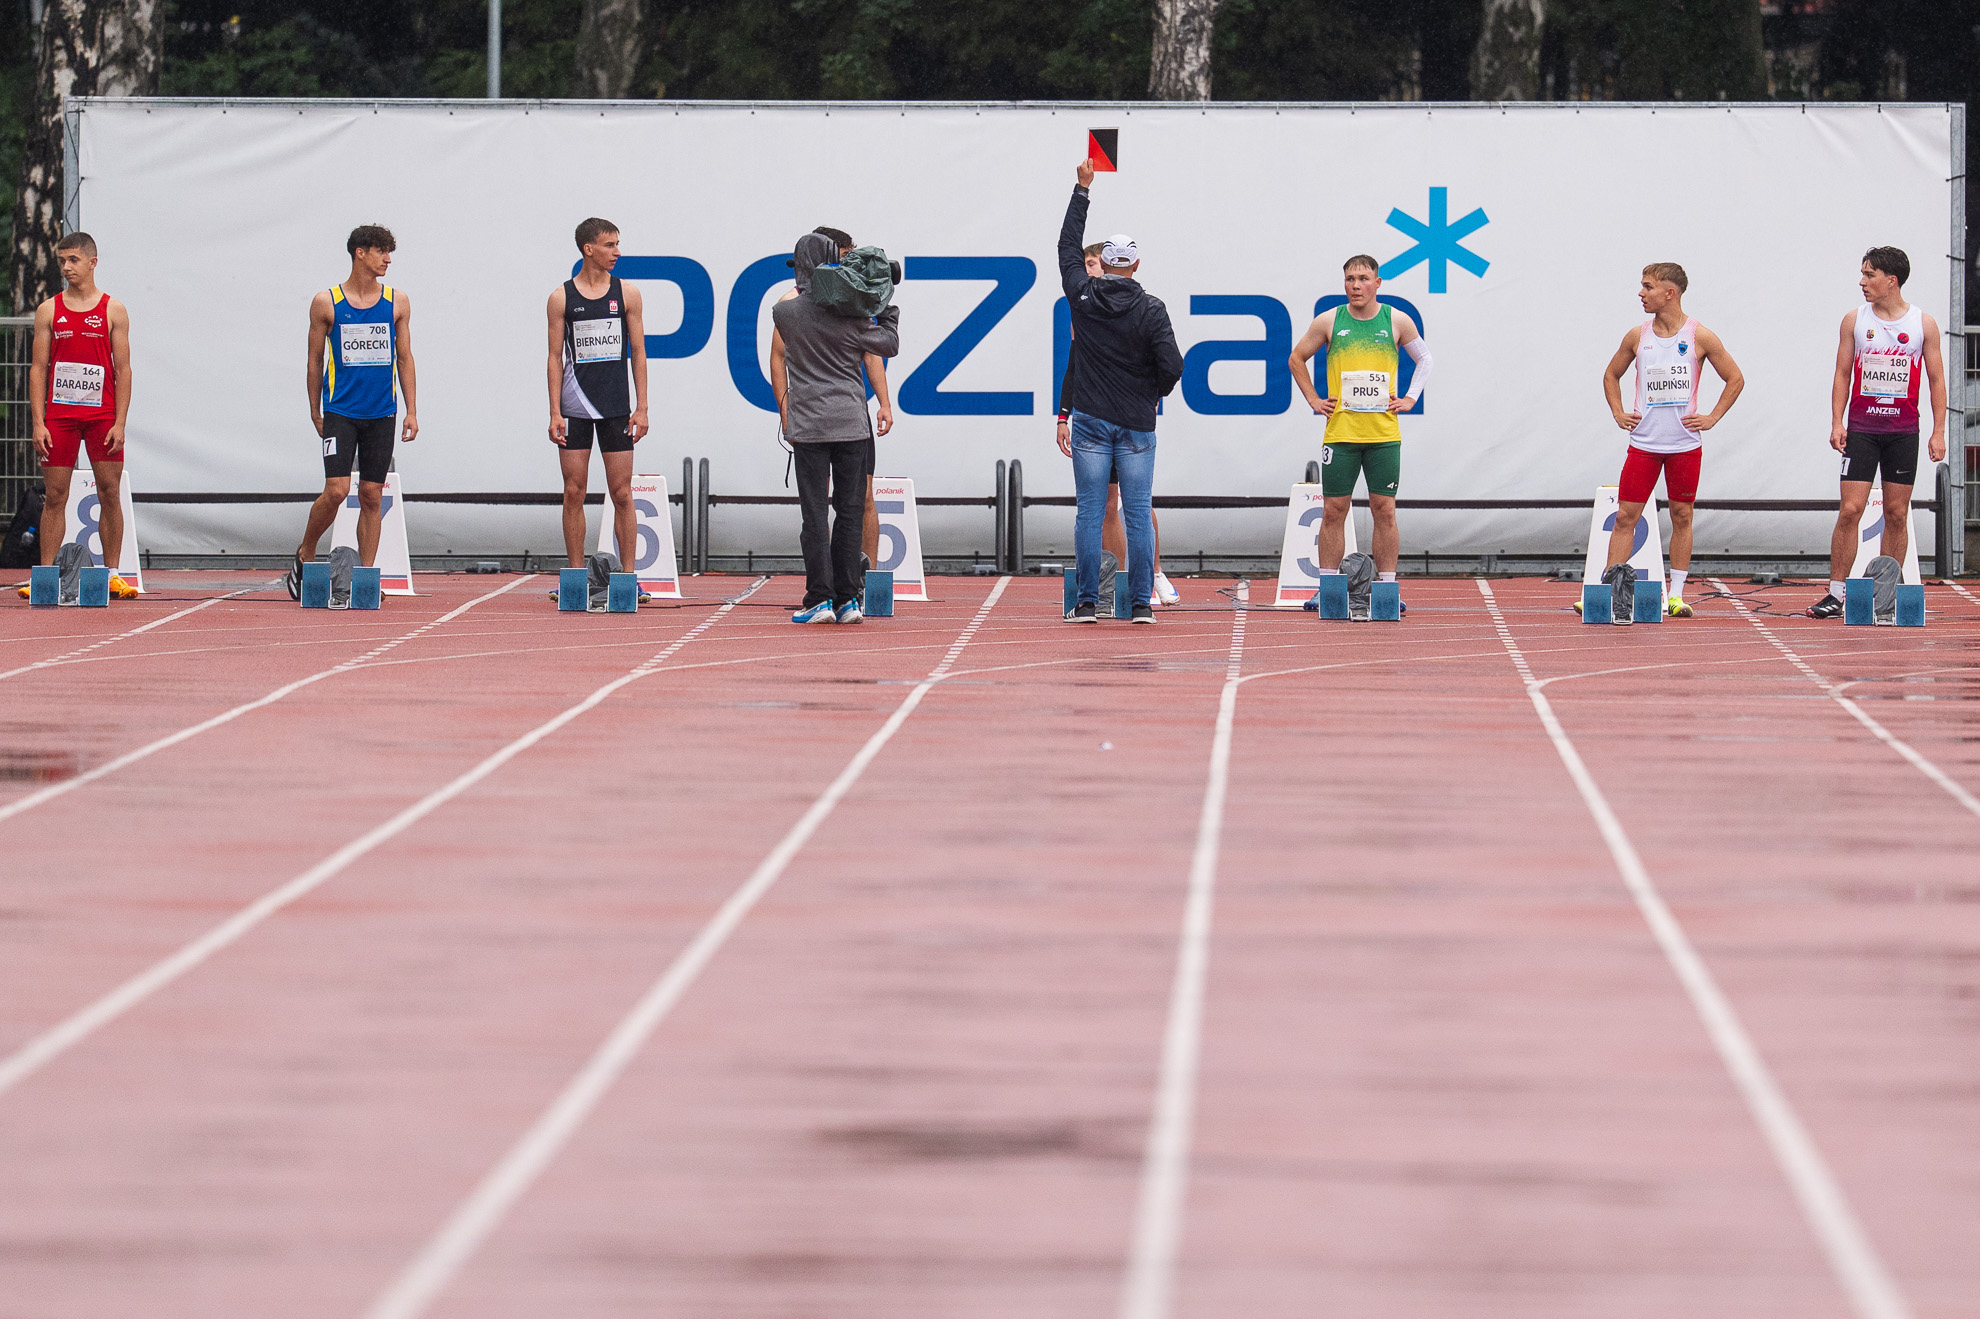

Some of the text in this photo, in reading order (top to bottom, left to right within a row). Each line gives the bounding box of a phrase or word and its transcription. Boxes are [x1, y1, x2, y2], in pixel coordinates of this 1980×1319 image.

[369, 326, 386, 335] 708
[606, 321, 612, 329] 7
[343, 338, 389, 350] GÓRECKI
[576, 335, 620, 347] BIERNACKI
[1890, 358, 1907, 367] 180
[82, 367, 100, 376] 164
[1670, 366, 1687, 374] 531
[1863, 370, 1908, 382] MARIASZ
[1369, 374, 1386, 382] 551
[56, 379, 101, 391] BARABAS
[1647, 378, 1690, 391] KULPIŃSKI
[1353, 387, 1379, 396] PRUS
[1865, 405, 1901, 415] JANZEN
[325, 439, 332, 454] 7
[1322, 447, 1329, 463] 3
[1841, 459, 1847, 473] 1
[875, 487, 904, 495] polanik
[612, 498, 660, 571] 6
[874, 501, 907, 571] 5
